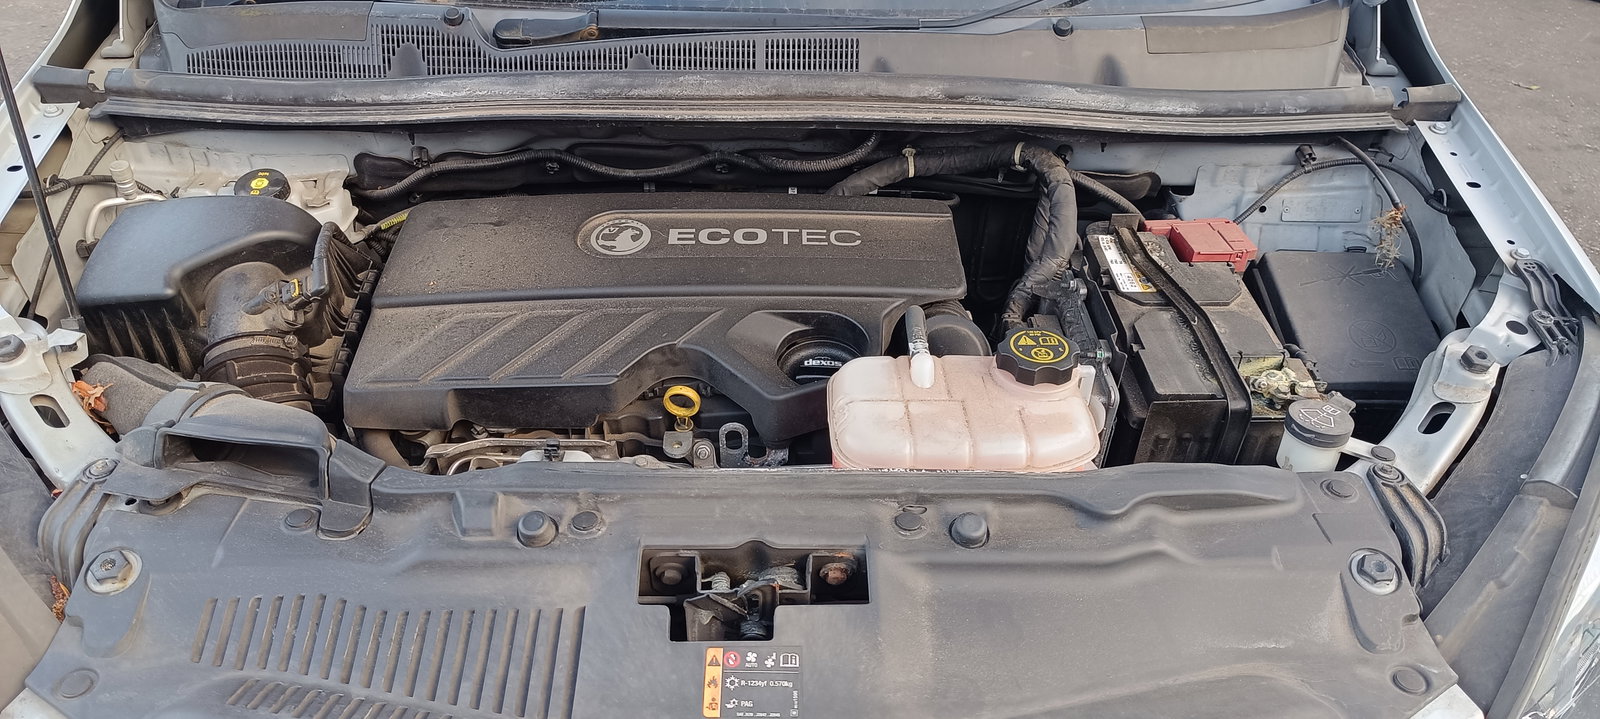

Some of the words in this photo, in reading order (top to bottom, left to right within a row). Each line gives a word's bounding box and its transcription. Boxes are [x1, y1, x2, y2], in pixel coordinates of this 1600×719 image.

[668, 228, 862, 246] ECOTEC
[804, 358, 842, 367] dexos
[741, 680, 767, 688] R-1234yf
[741, 700, 753, 708] PAG
